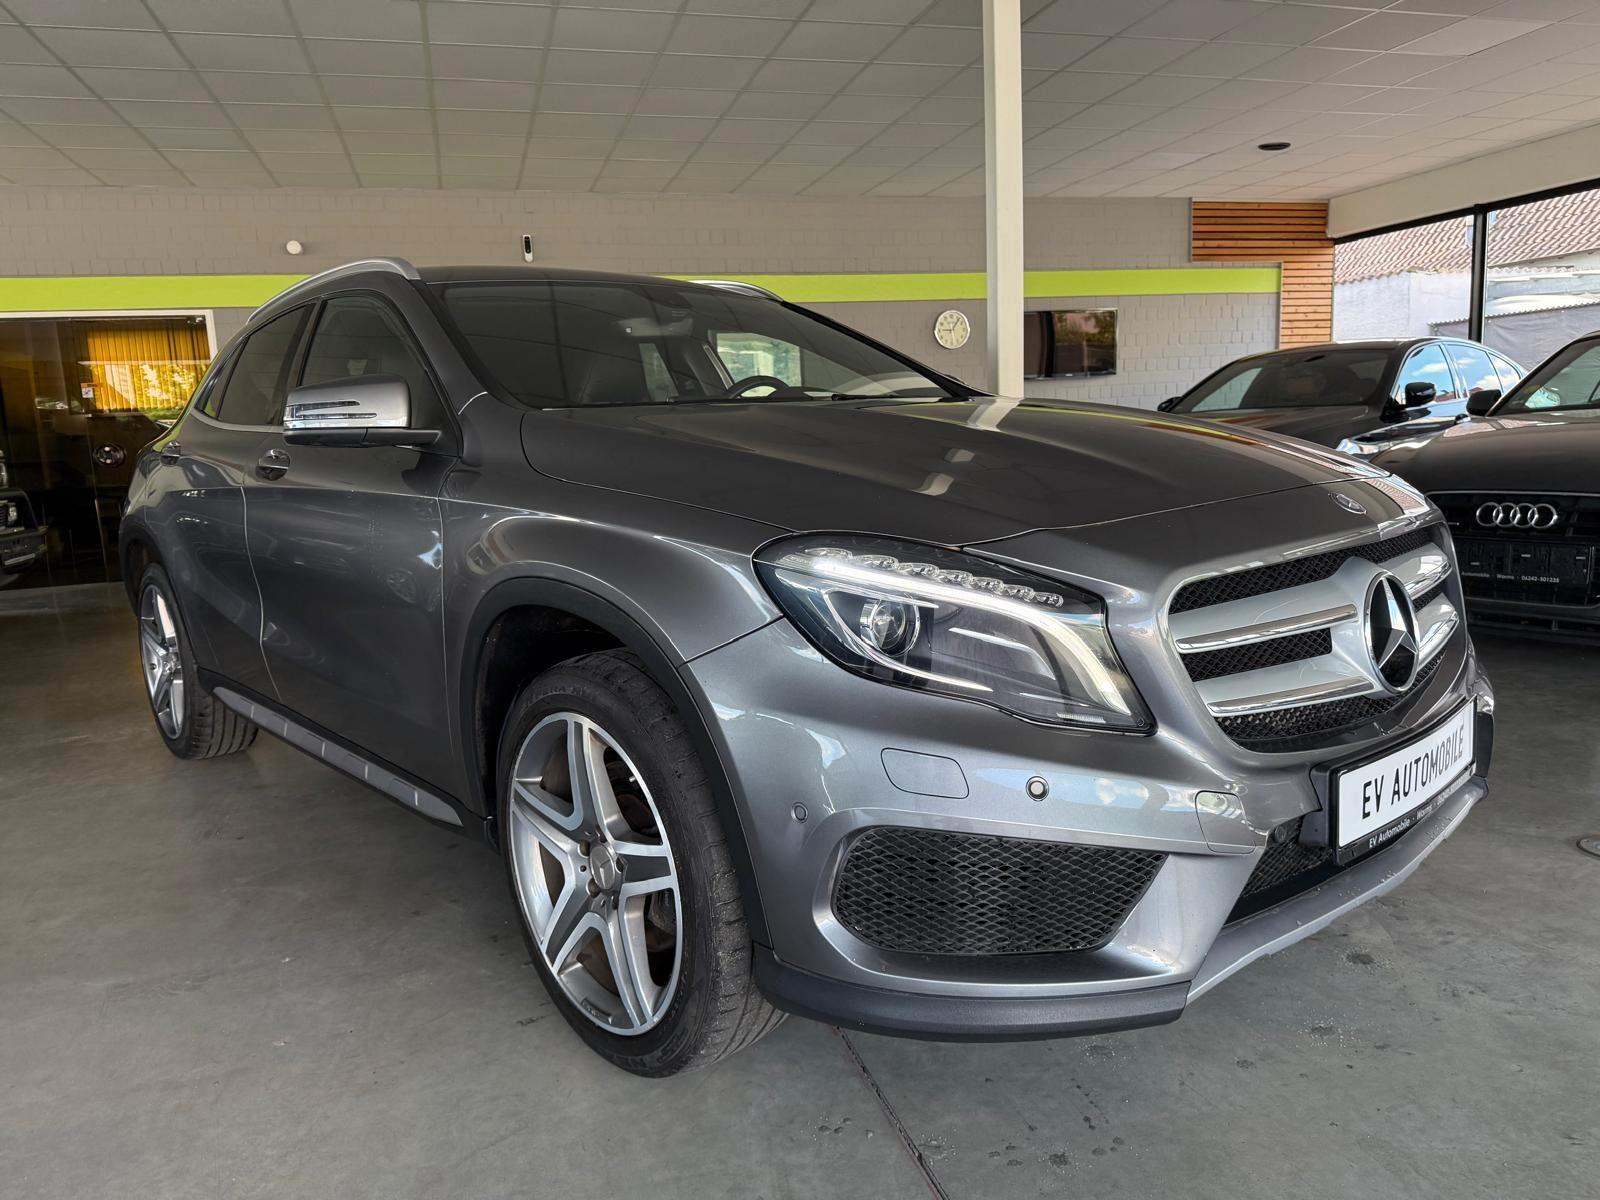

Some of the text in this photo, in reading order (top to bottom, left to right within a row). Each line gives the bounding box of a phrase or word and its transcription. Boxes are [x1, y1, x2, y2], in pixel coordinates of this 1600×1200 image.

[1362, 775, 1385, 819] EV
[1391, 724, 1464, 805] AUTOMOBILE
[1368, 837, 1378, 848] EV
[1378, 818, 1411, 843] Automobile
